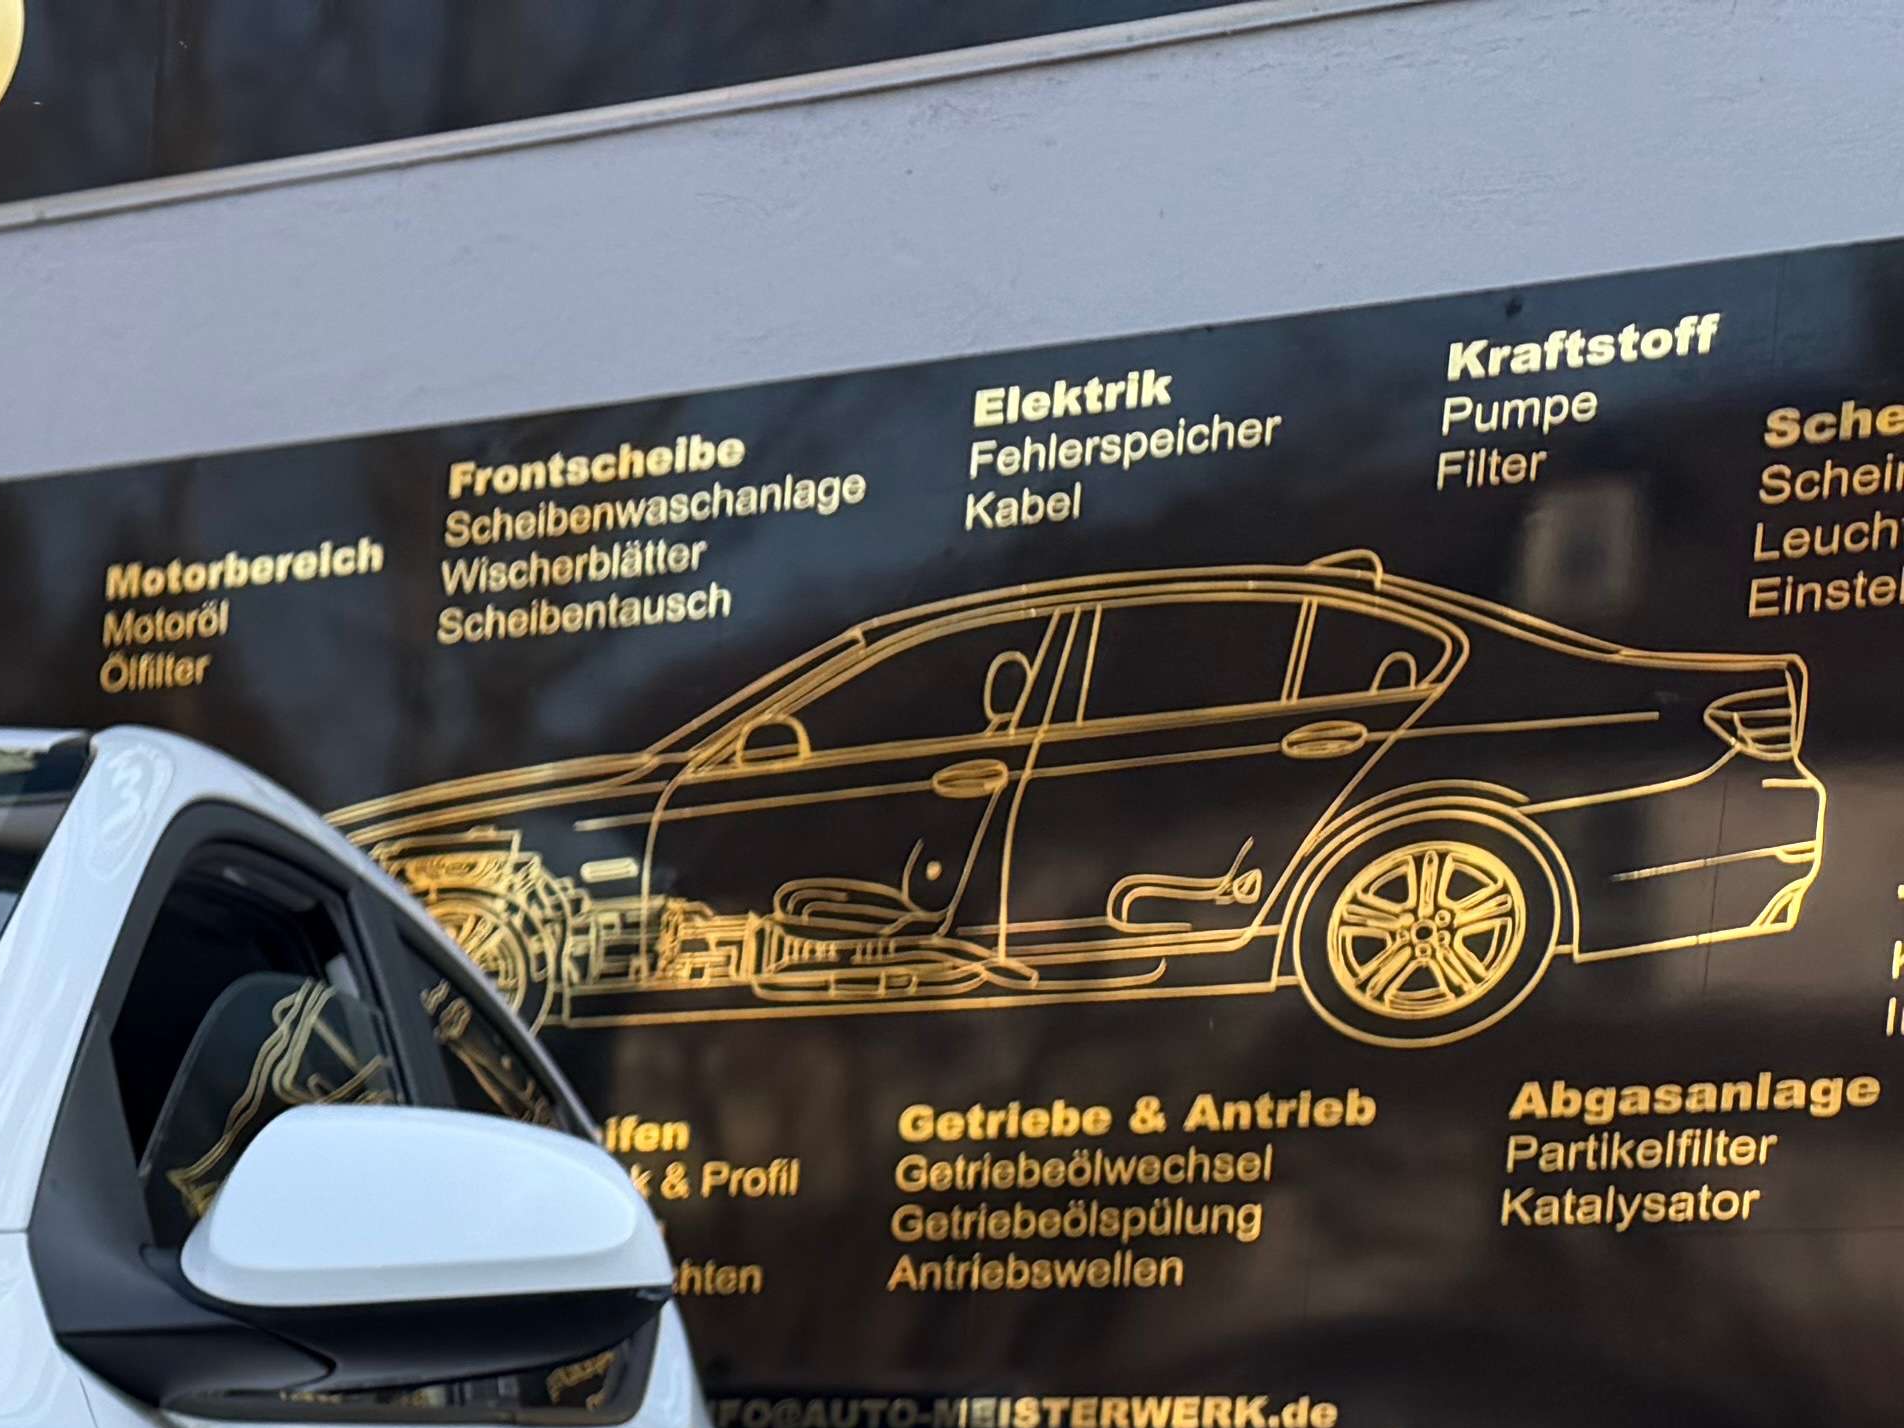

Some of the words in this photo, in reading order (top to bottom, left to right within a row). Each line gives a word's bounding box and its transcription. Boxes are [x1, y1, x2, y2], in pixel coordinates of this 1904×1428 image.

[1447, 312, 1720, 382] Kraftstoff
[972, 368, 1173, 428] Elektrik
[1442, 391, 1599, 437] Pumpe
[447, 434, 746, 500] Frontscheibe
[969, 413, 1283, 480] Fehlerspeicher
[1436, 447, 1548, 491] Filter
[444, 472, 867, 548] Scheibenwaschanlage
[964, 480, 1083, 532] Kabel
[1753, 509, 1904, 562] Leuch
[104, 535, 385, 601] Motorbereich
[441, 537, 708, 596] Wischerblätter
[102, 598, 230, 650] Motoröl
[436, 580, 732, 645] Scheibentausch
[99, 650, 213, 695] Ölfilter
[898, 1098, 1113, 1143] Getriebe
[1129, 1095, 1168, 1136] &
[1183, 1088, 1378, 1133] Antrieb
[1507, 1071, 1882, 1126] Abgasanlage
[894, 1143, 1274, 1192] Getriebeölwechsel
[1505, 1128, 1778, 1174] Partikelfilter
[660, 1161, 690, 1200] &
[699, 1157, 801, 1199] Profil
[890, 1197, 1264, 1245] Getriebeölspülung
[1500, 1182, 1761, 1233] Katalysator
[886, 1248, 1185, 1293] Antriebswellen
